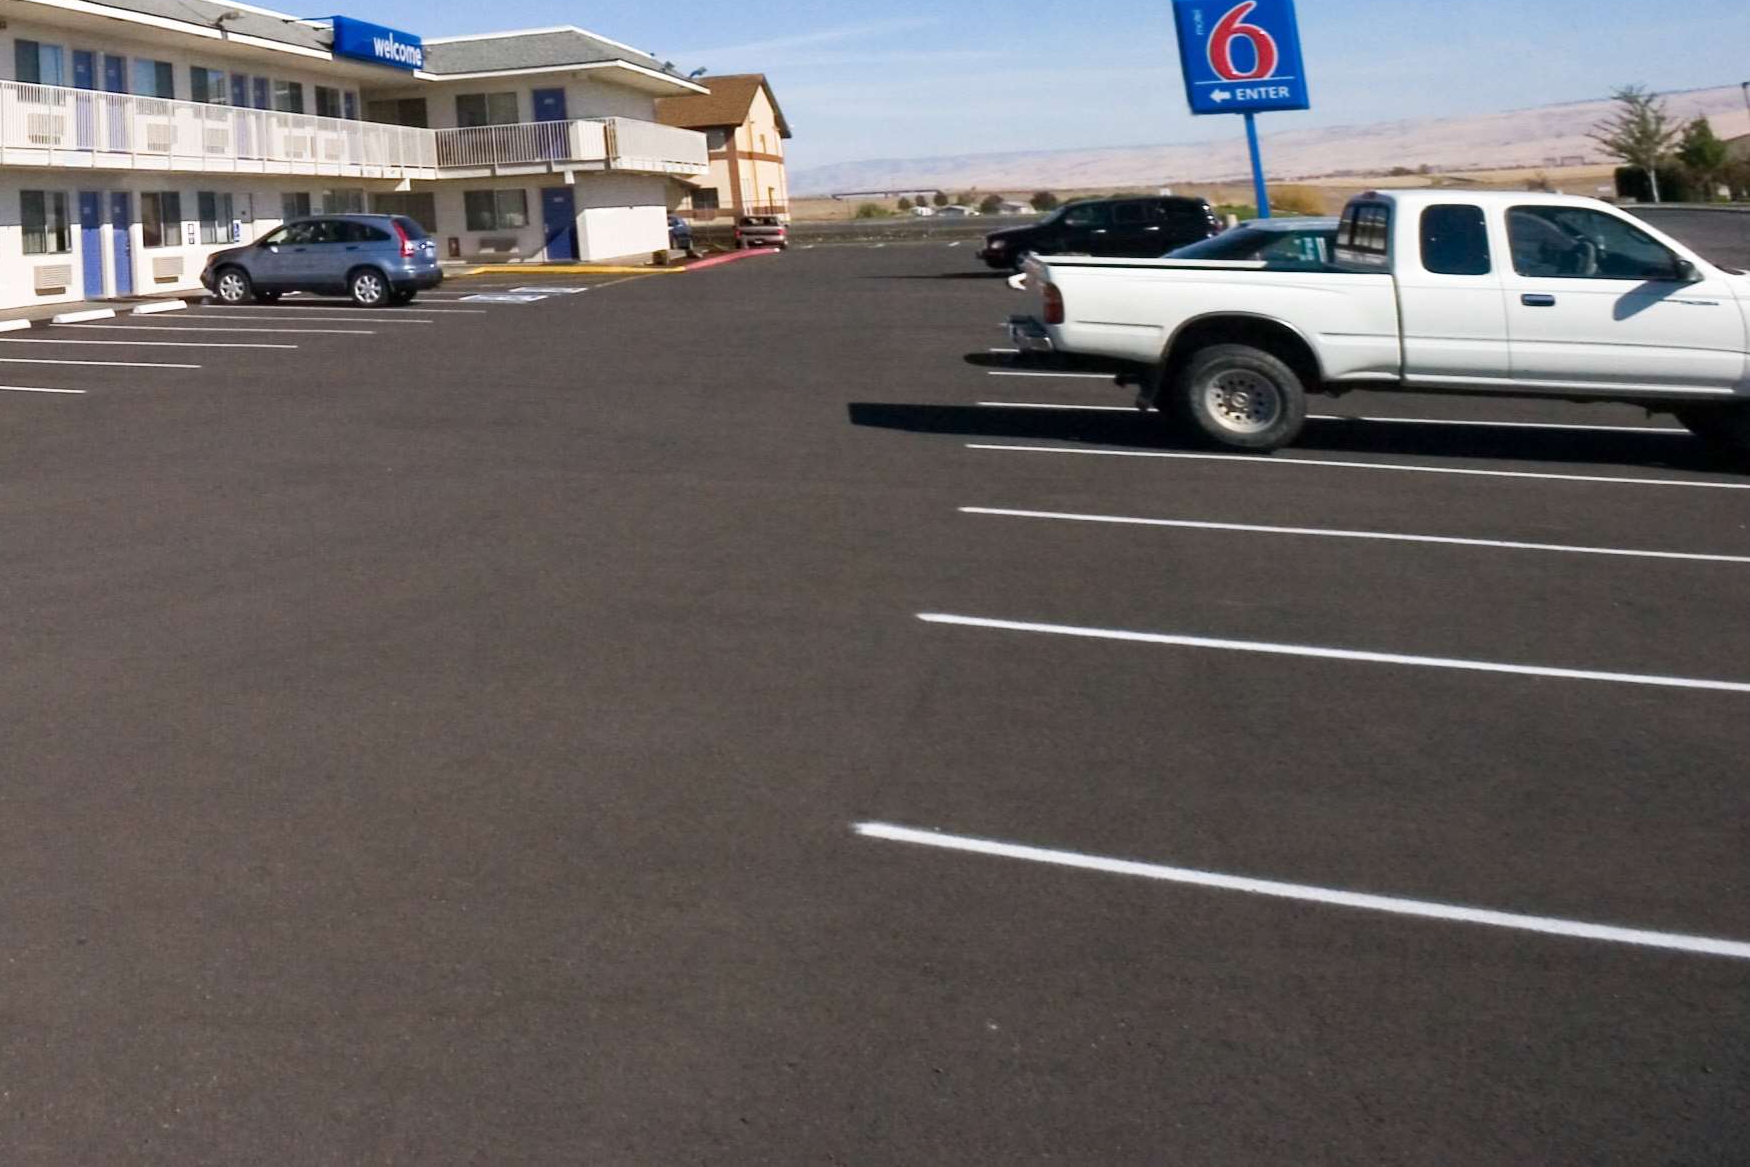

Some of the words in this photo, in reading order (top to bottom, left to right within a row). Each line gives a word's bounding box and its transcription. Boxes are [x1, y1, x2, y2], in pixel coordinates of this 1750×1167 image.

[373, 32, 421, 66] welcome
[1207, 0, 1278, 82] 6
[1235, 86, 1290, 101] ENTER
